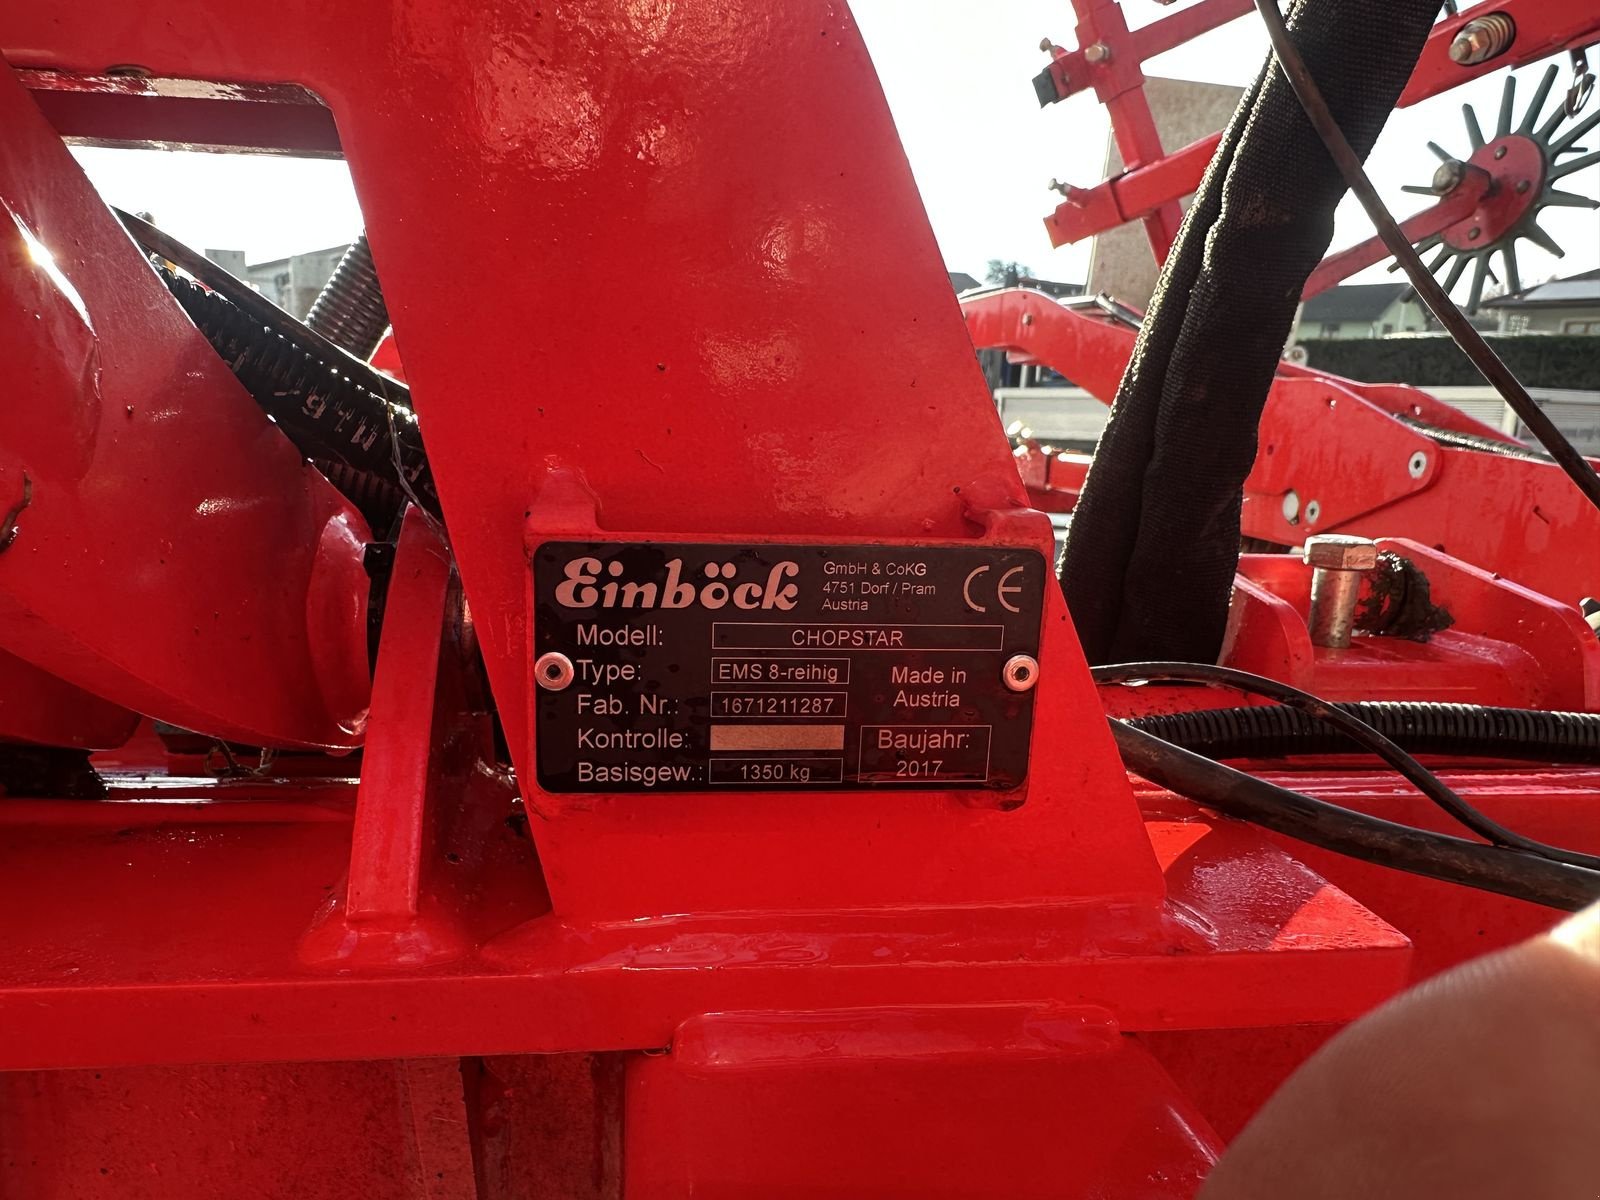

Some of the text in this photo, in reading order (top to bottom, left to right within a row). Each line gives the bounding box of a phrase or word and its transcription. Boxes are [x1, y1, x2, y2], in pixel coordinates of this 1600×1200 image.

[823, 561, 926, 576] GmbH & CoKG
[555, 557, 799, 610] Einböck
[823, 581, 855, 594] 4751
[861, 582, 889, 594] Dorf
[902, 583, 935, 594] Pram
[822, 599, 868, 610] Austria
[577, 624, 663, 646] Modell:
[791, 630, 904, 647] CHOPSTAR
[576, 660, 642, 684] Type:
[720, 664, 838, 684] EMS 8-reihig
[892, 667, 966, 683] Made in
[578, 694, 677, 714] Fab. Nr.:
[721, 697, 834, 714] 1671211287
[893, 690, 960, 708] Austria
[579, 728, 688, 748] Kontrolle:
[879, 730, 969, 753] Baujahr:
[579, 762, 701, 786] Basisgew.:
[740, 765, 811, 783] 1350 kg
[897, 761, 942, 776] 2017
